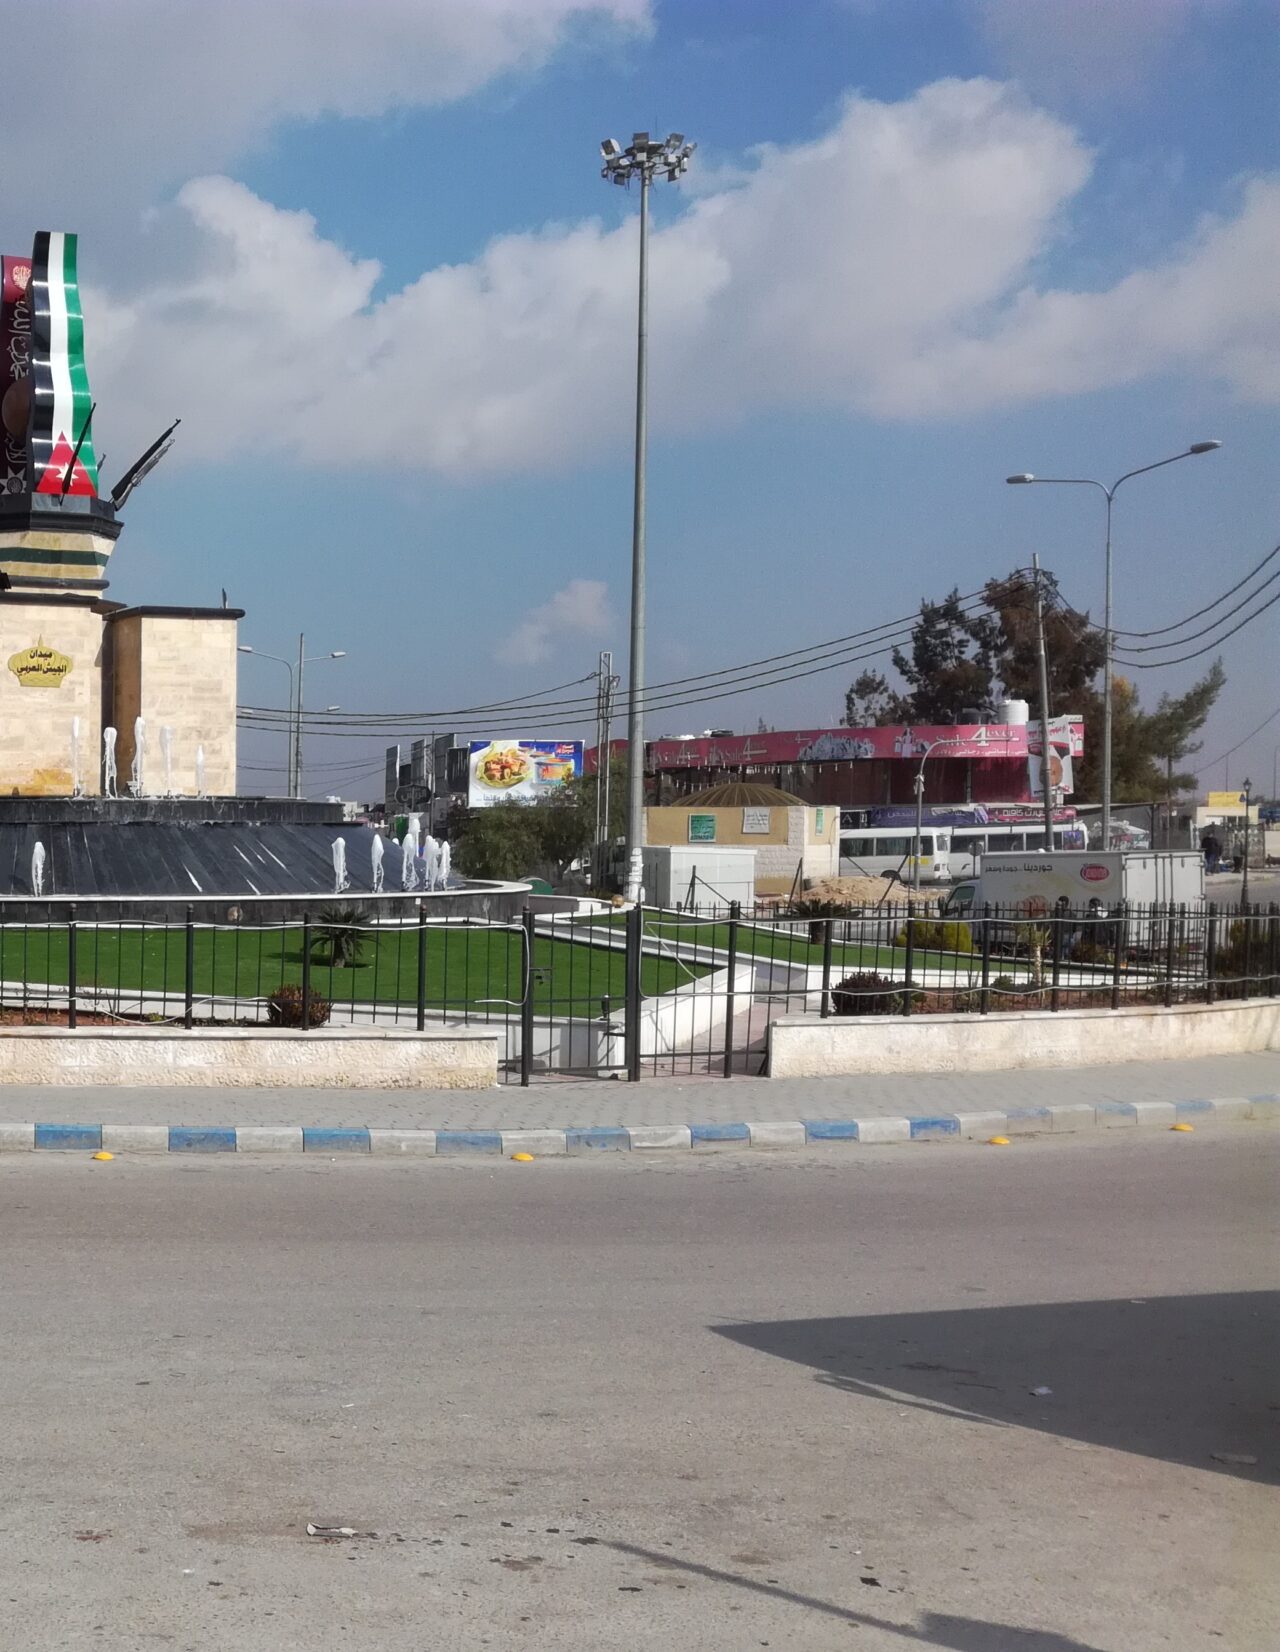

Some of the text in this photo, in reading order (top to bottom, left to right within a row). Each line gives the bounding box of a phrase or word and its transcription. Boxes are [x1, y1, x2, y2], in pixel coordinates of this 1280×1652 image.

[29, 649, 53, 661] ميدان
[16, 662, 67, 676] الجيش العربي
